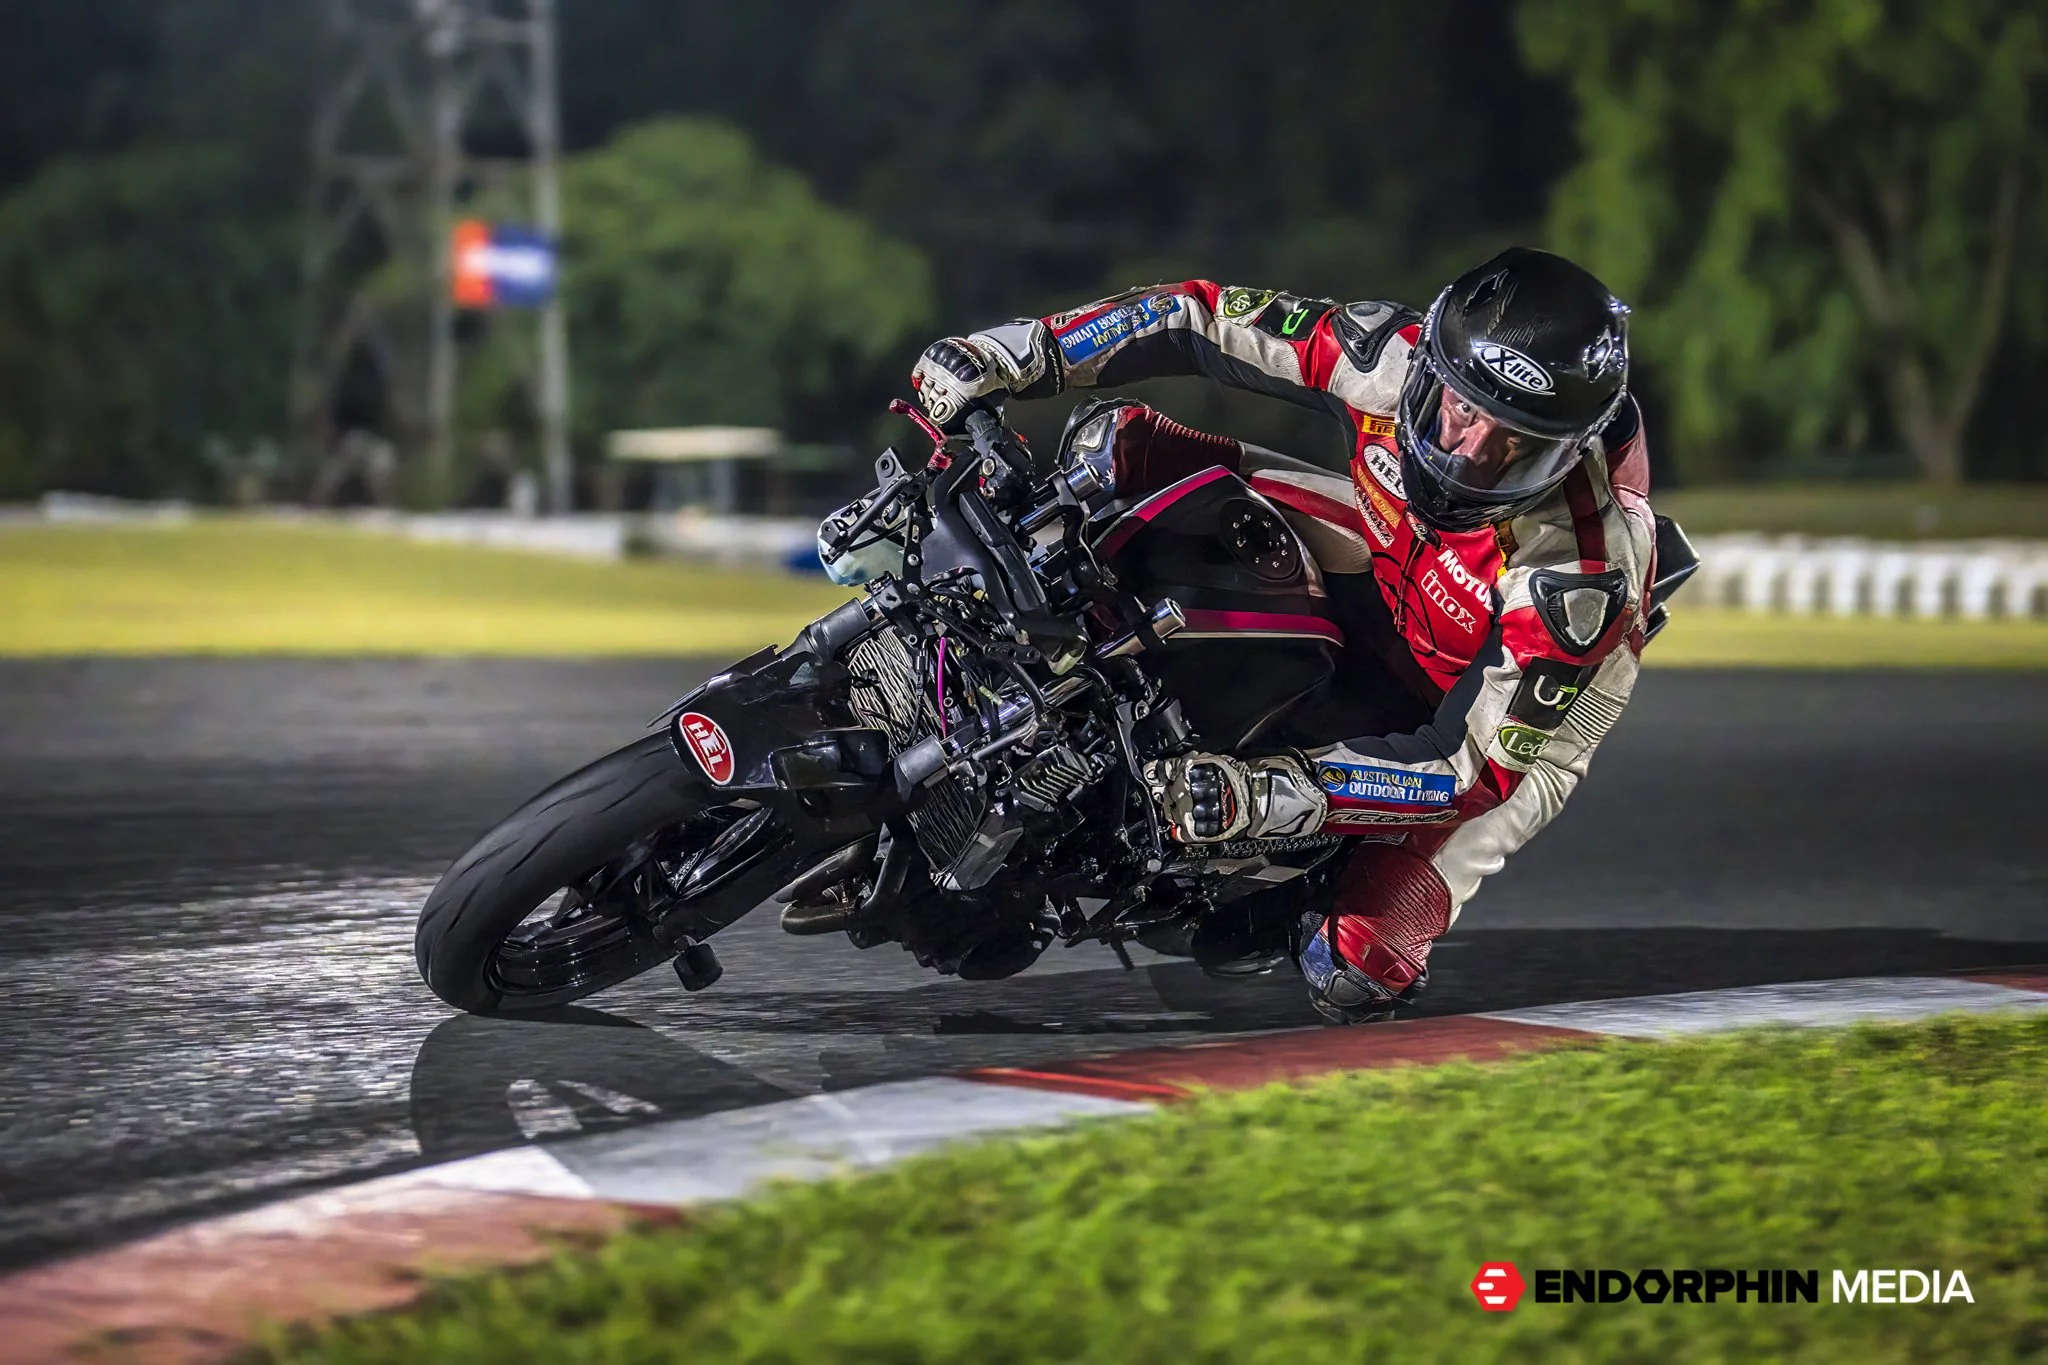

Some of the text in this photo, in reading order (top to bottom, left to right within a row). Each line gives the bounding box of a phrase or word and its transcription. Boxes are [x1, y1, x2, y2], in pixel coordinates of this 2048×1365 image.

[1485, 347, 1543, 389] X-lite
[1420, 568, 1477, 634] inox
[686, 720, 724, 774] HEL
[1348, 781, 1406, 800] OUTDOOR
[1350, 769, 1423, 789] AUSTRALIAN
